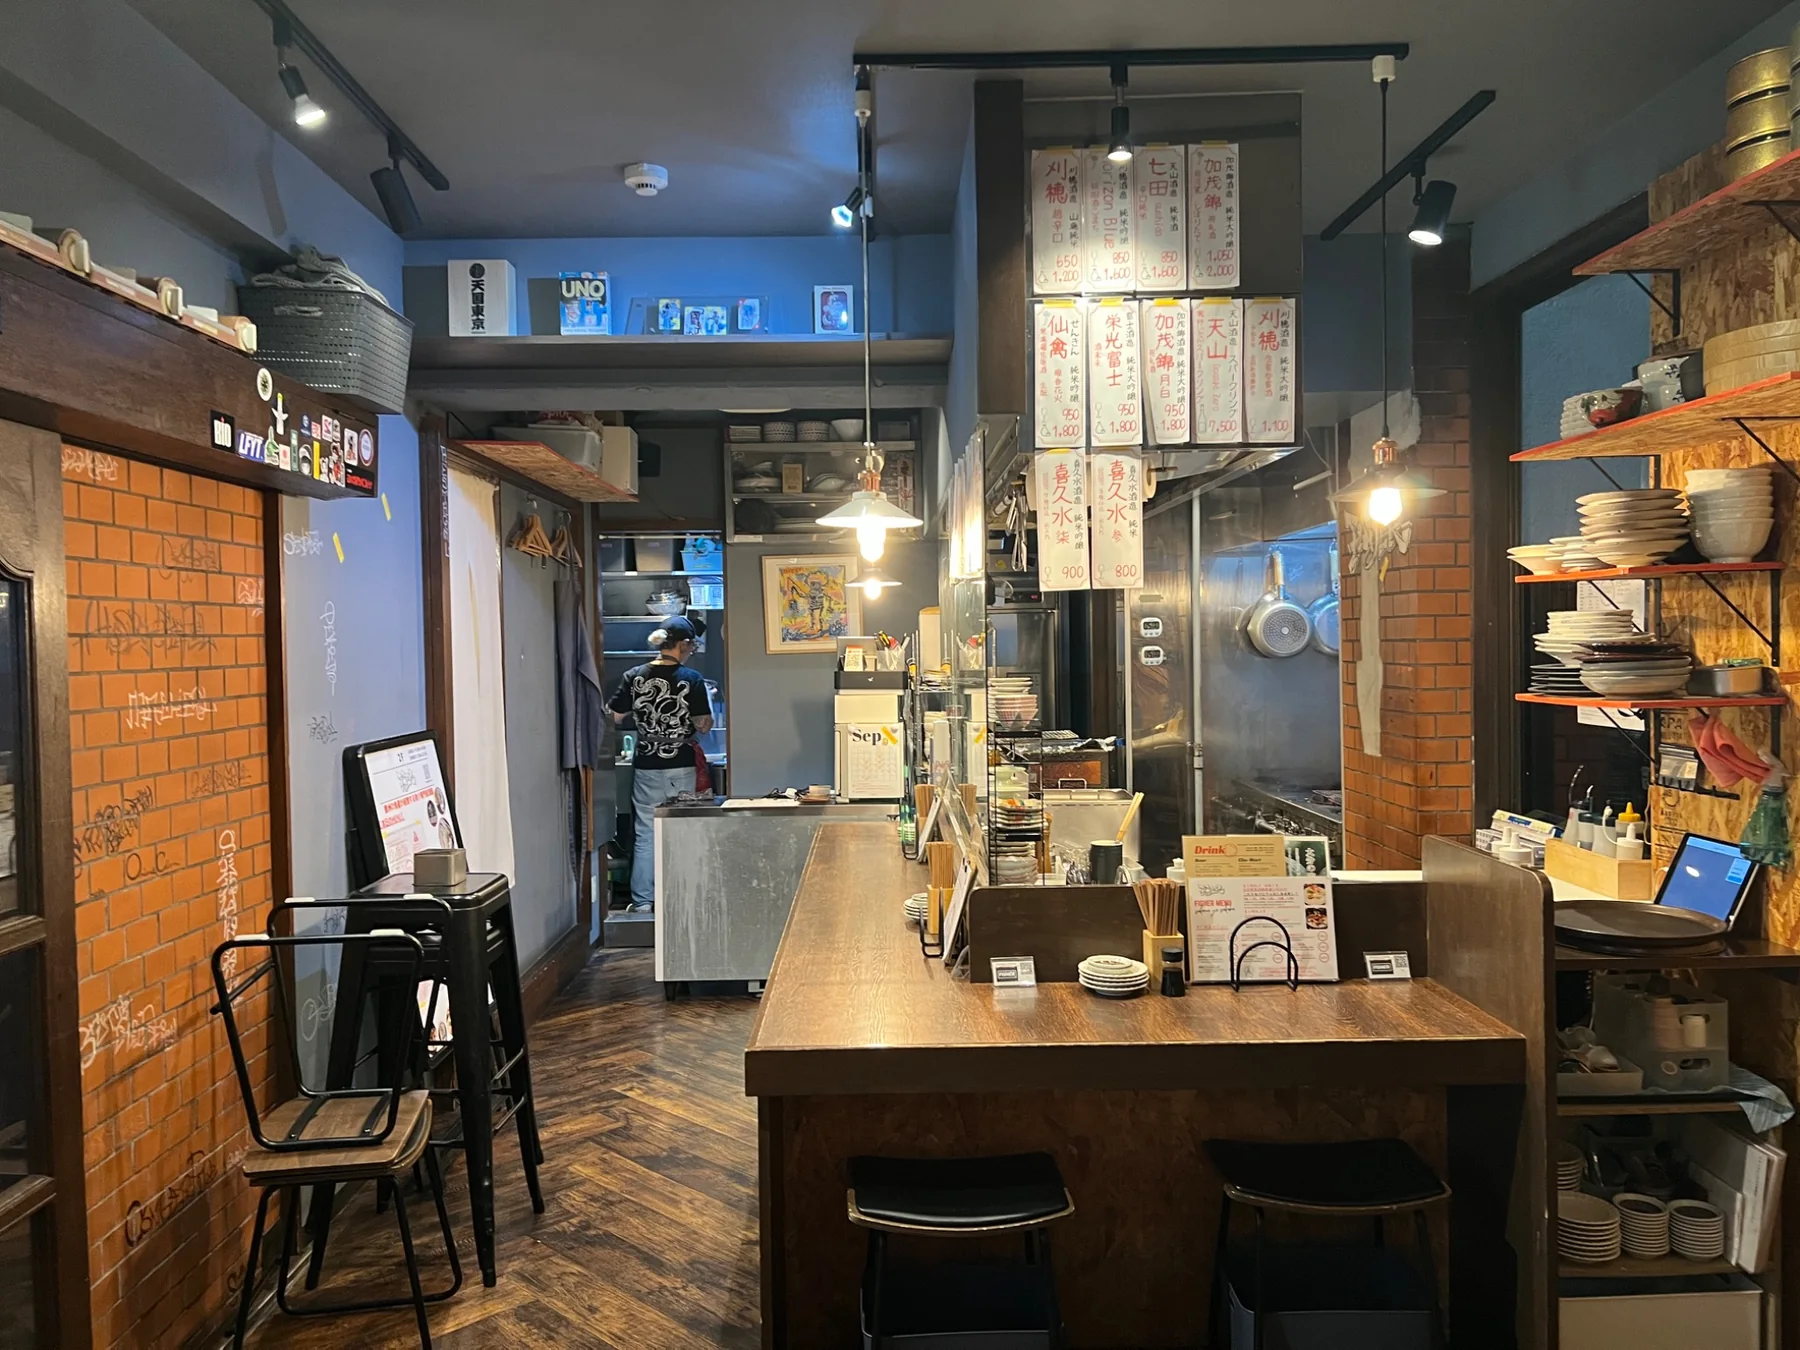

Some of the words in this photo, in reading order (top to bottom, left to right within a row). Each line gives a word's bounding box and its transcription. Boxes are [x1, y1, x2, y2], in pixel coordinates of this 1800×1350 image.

[1045, 158, 1068, 204] 刈穂
[1102, 160, 1116, 210] orizon
[1149, 158, 1168, 196] 七田
[1103, 217, 1118, 249] Blue
[1056, 254, 1078, 268] 650
[1112, 251, 1130, 264] 850
[1161, 250, 1178, 263] 850
[561, 280, 605, 299] UNO
[1258, 308, 1280, 351] 刈穂
[1207, 318, 1228, 359] 天山
[1062, 408, 1080, 421] 950
[1117, 403, 1136, 416] 950
[1164, 404, 1186, 417] 950
[1052, 462, 1073, 527] 喜久水
[1107, 459, 1128, 524] 喜久水
[1062, 566, 1084, 579] 900
[1115, 564, 1137, 577] 800
[851, 729, 882, 746] Sep
[1194, 845, 1225, 855] Drink
